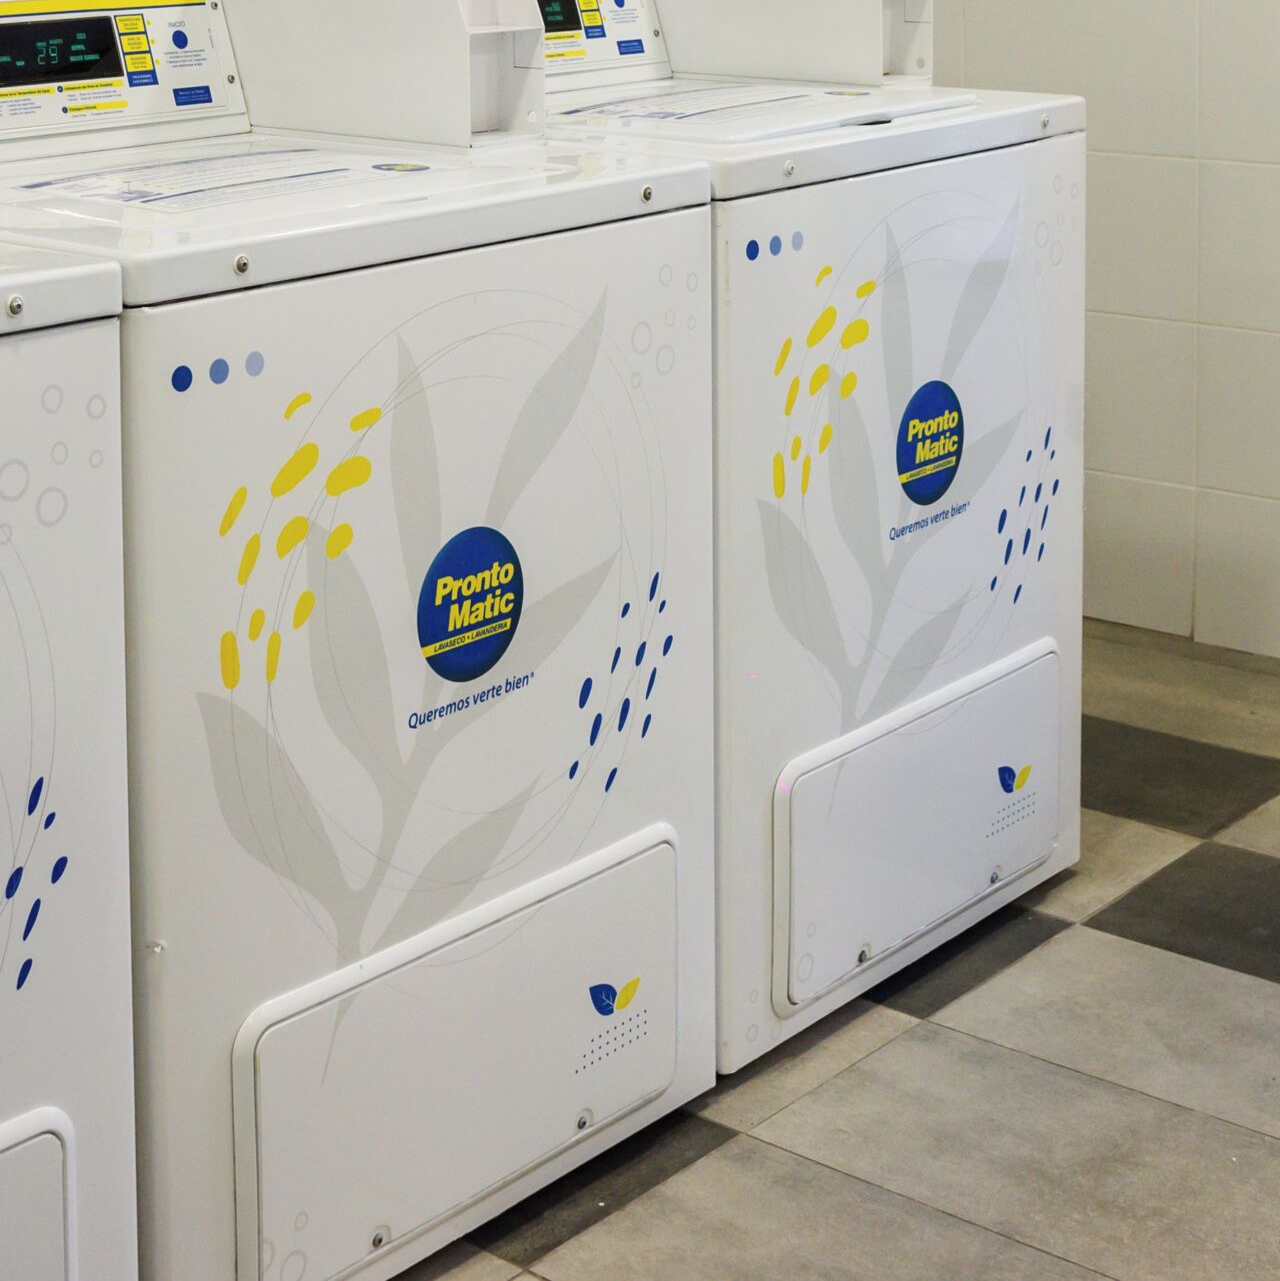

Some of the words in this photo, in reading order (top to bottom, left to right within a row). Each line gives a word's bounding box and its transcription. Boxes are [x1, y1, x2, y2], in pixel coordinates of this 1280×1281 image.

[37, 45, 59, 65] 29
[907, 409, 959, 443] Pronto
[915, 432, 959, 464] Matic
[889, 517, 929, 541] Queremos
[930, 508, 950, 526] verte
[435, 561, 514, 606] Pronto
[448, 589, 515, 632] Matic
[434, 636, 465, 654] LAVASECO
[408, 696, 470, 730] Queremos
[473, 684, 502, 706] verte
